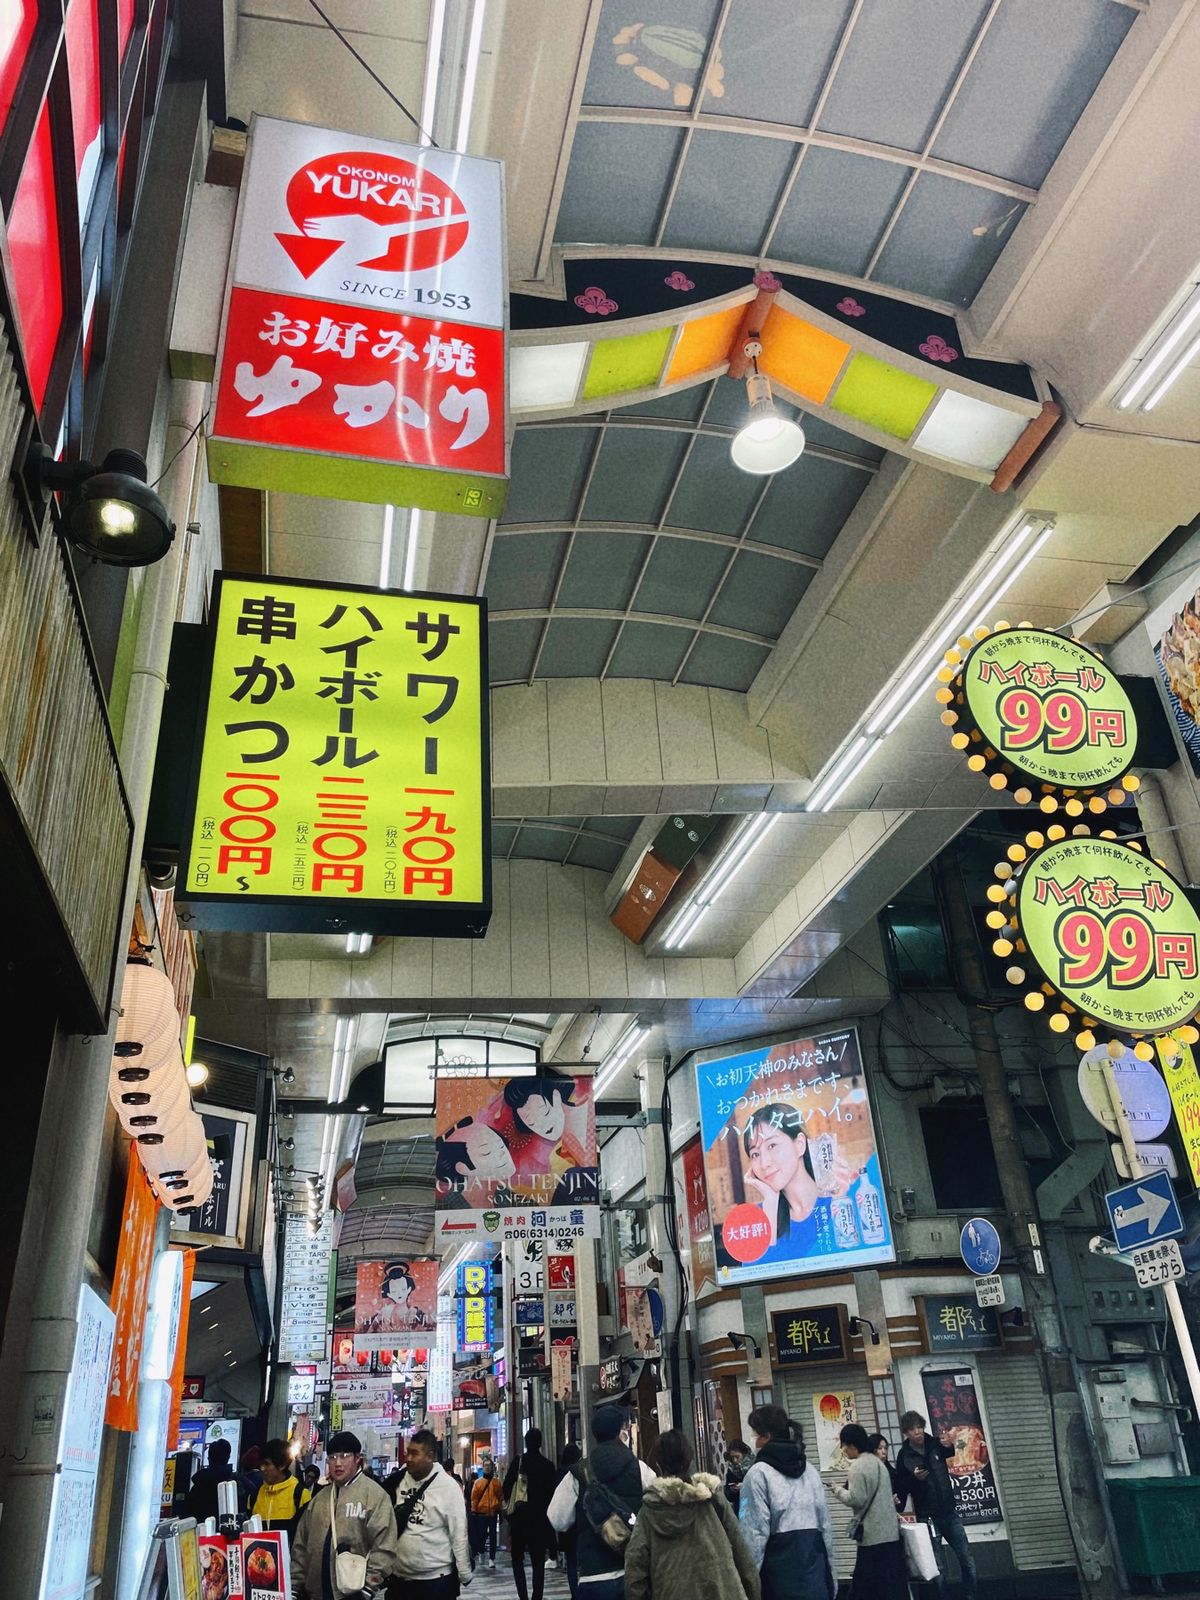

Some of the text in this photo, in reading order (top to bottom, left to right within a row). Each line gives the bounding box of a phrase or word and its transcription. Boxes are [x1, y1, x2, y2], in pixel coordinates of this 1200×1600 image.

[337, 164, 421, 188] OKONOMI
[306, 170, 452, 217] YUKARI
[340, 280, 472, 311] SINCE 1953
[258, 311, 477, 378] お好み焼
[233, 354, 490, 450] ゆかり
[985, 635, 1086, 664] 朝から晩まで何杯飲んでも
[224, 595, 297, 764] 串かつ
[310, 604, 384, 769] ハイボール
[405, 611, 460, 775] サワー
[978, 660, 1105, 693] ハイボール
[995, 685, 1128, 755] 99円
[1018, 755, 1123, 782] 朝から晩まで何杯飲んでも
[1040, 845, 1153, 876] 朝から晩まで何杯飲んでも
[1034, 875, 1174, 913] ハイボール
[1053, 906, 1199, 991] 99円
[1079, 990, 1195, 1023] 朝から晩まで何杯飲んでも
[435, 1172, 599, 1196] OHATSU TENJIN
[1133, 1244, 1176, 1267] 自転車を除く
[1138, 1259, 1182, 1285] ここから
[960, 1486, 995, 1502] 530円
